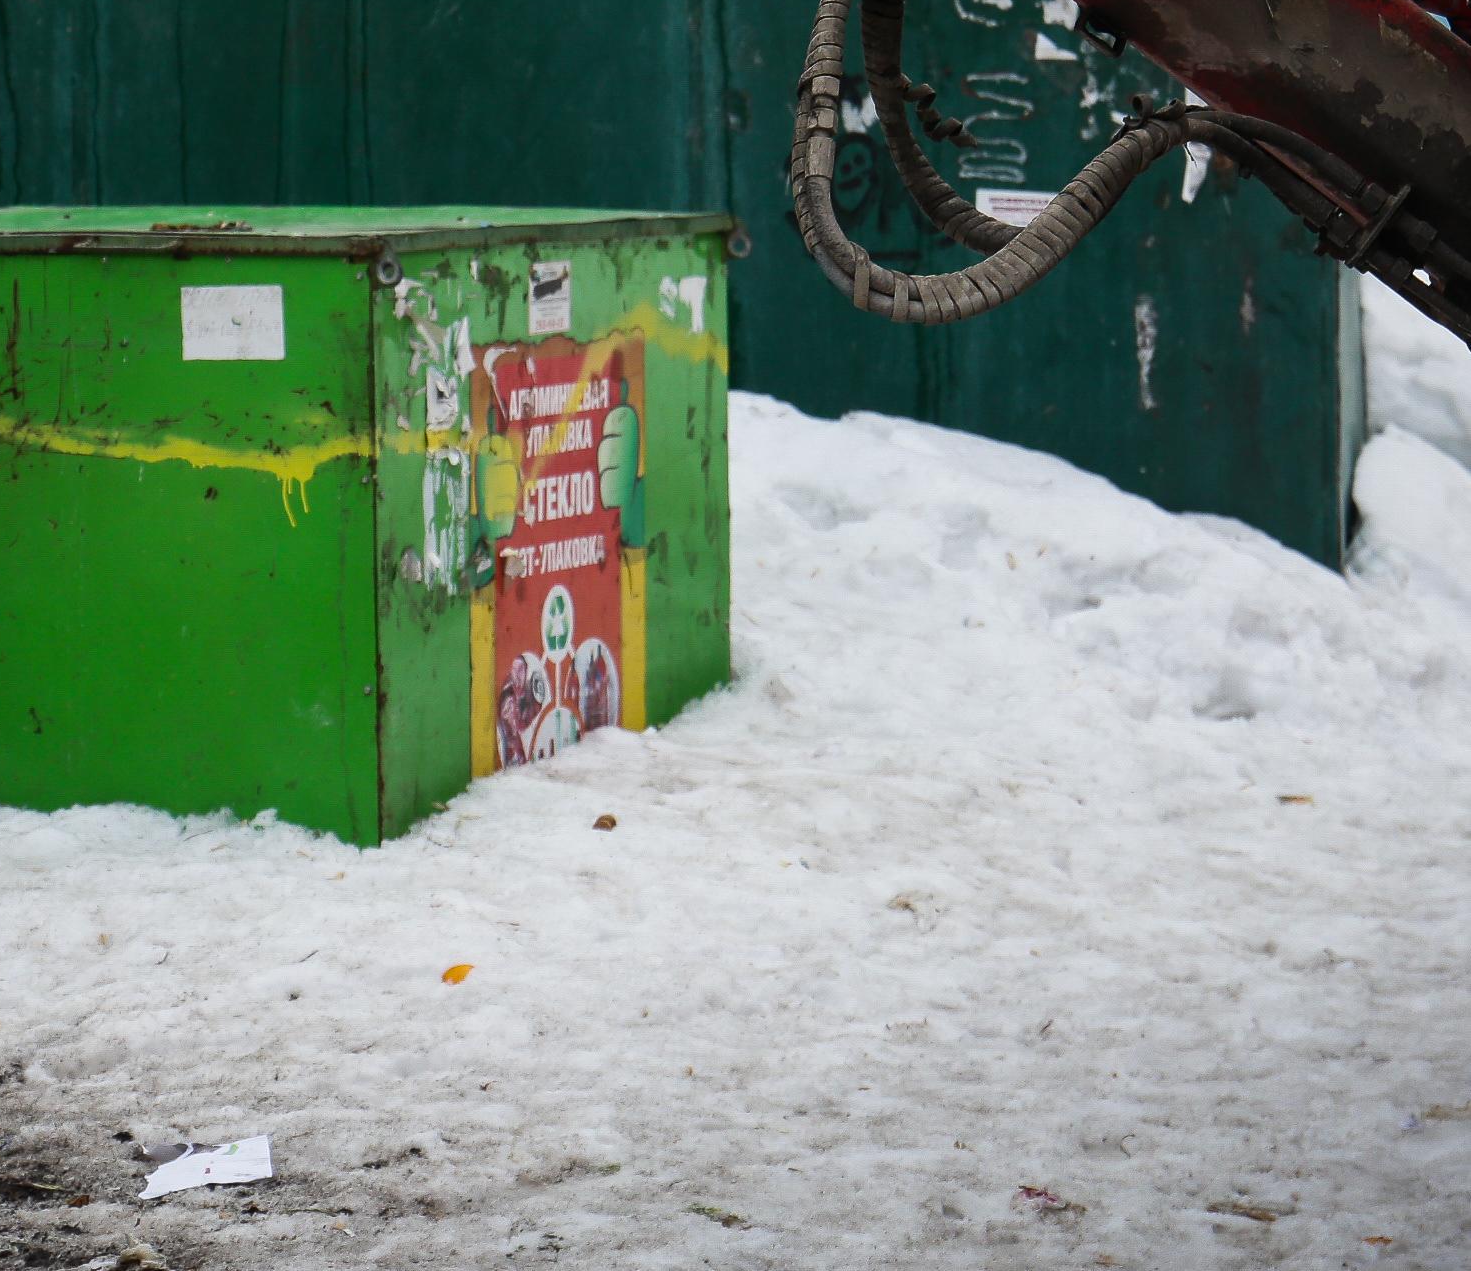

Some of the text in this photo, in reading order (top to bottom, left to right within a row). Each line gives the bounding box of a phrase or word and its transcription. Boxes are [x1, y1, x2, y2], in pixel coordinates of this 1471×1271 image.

[509, 379, 609, 421] АЛМИНВАЯ
[523, 471, 594, 527] СТЕКЛО
[507, 535, 605, 578] ЭТ-УПАКОВКА
